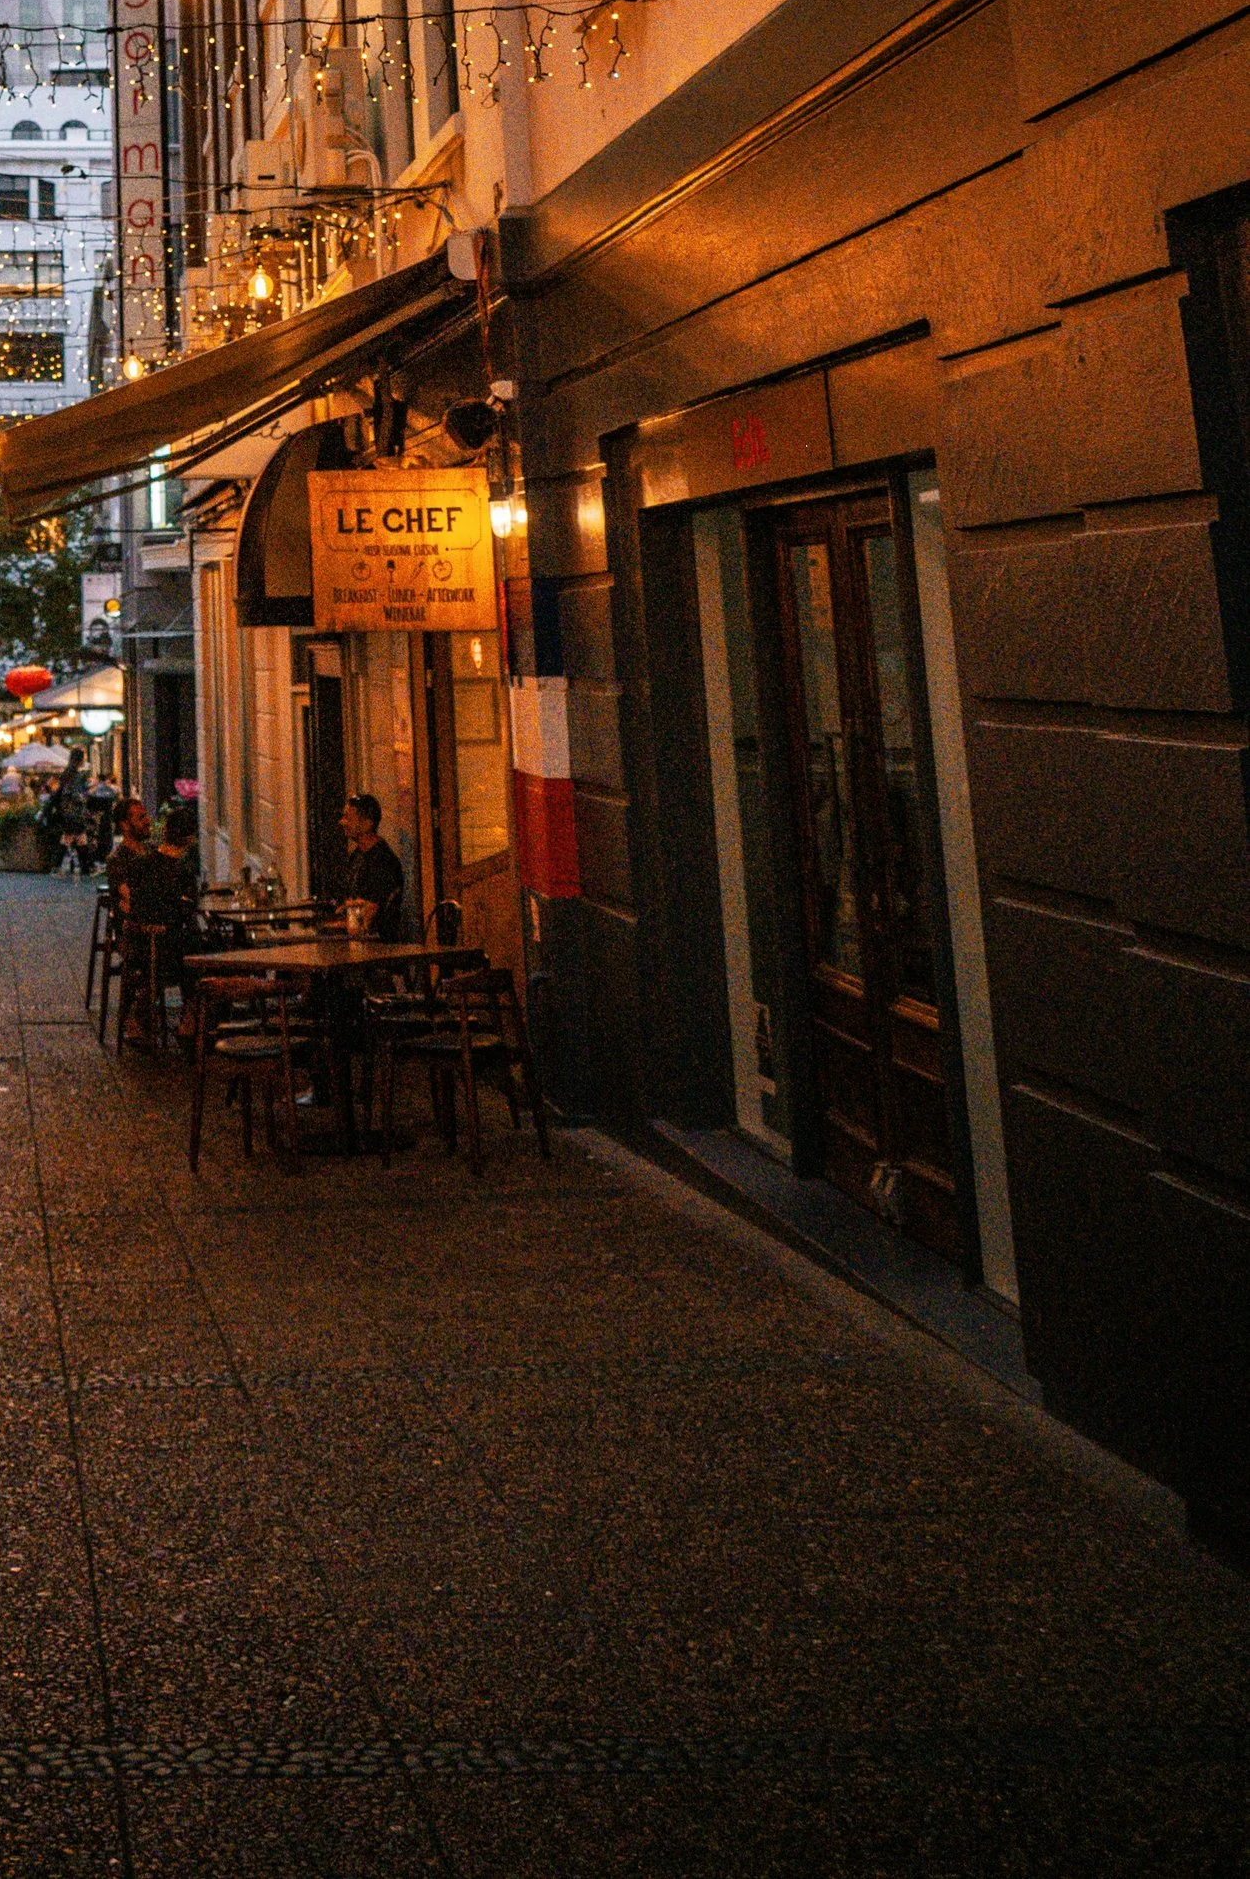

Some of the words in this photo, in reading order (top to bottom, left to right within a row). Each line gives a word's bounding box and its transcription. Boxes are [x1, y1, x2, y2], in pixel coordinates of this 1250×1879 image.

[336, 508, 374, 534] LE
[382, 506, 463, 533] CHEF
[333, 587, 377, 604] BREAKFAST
